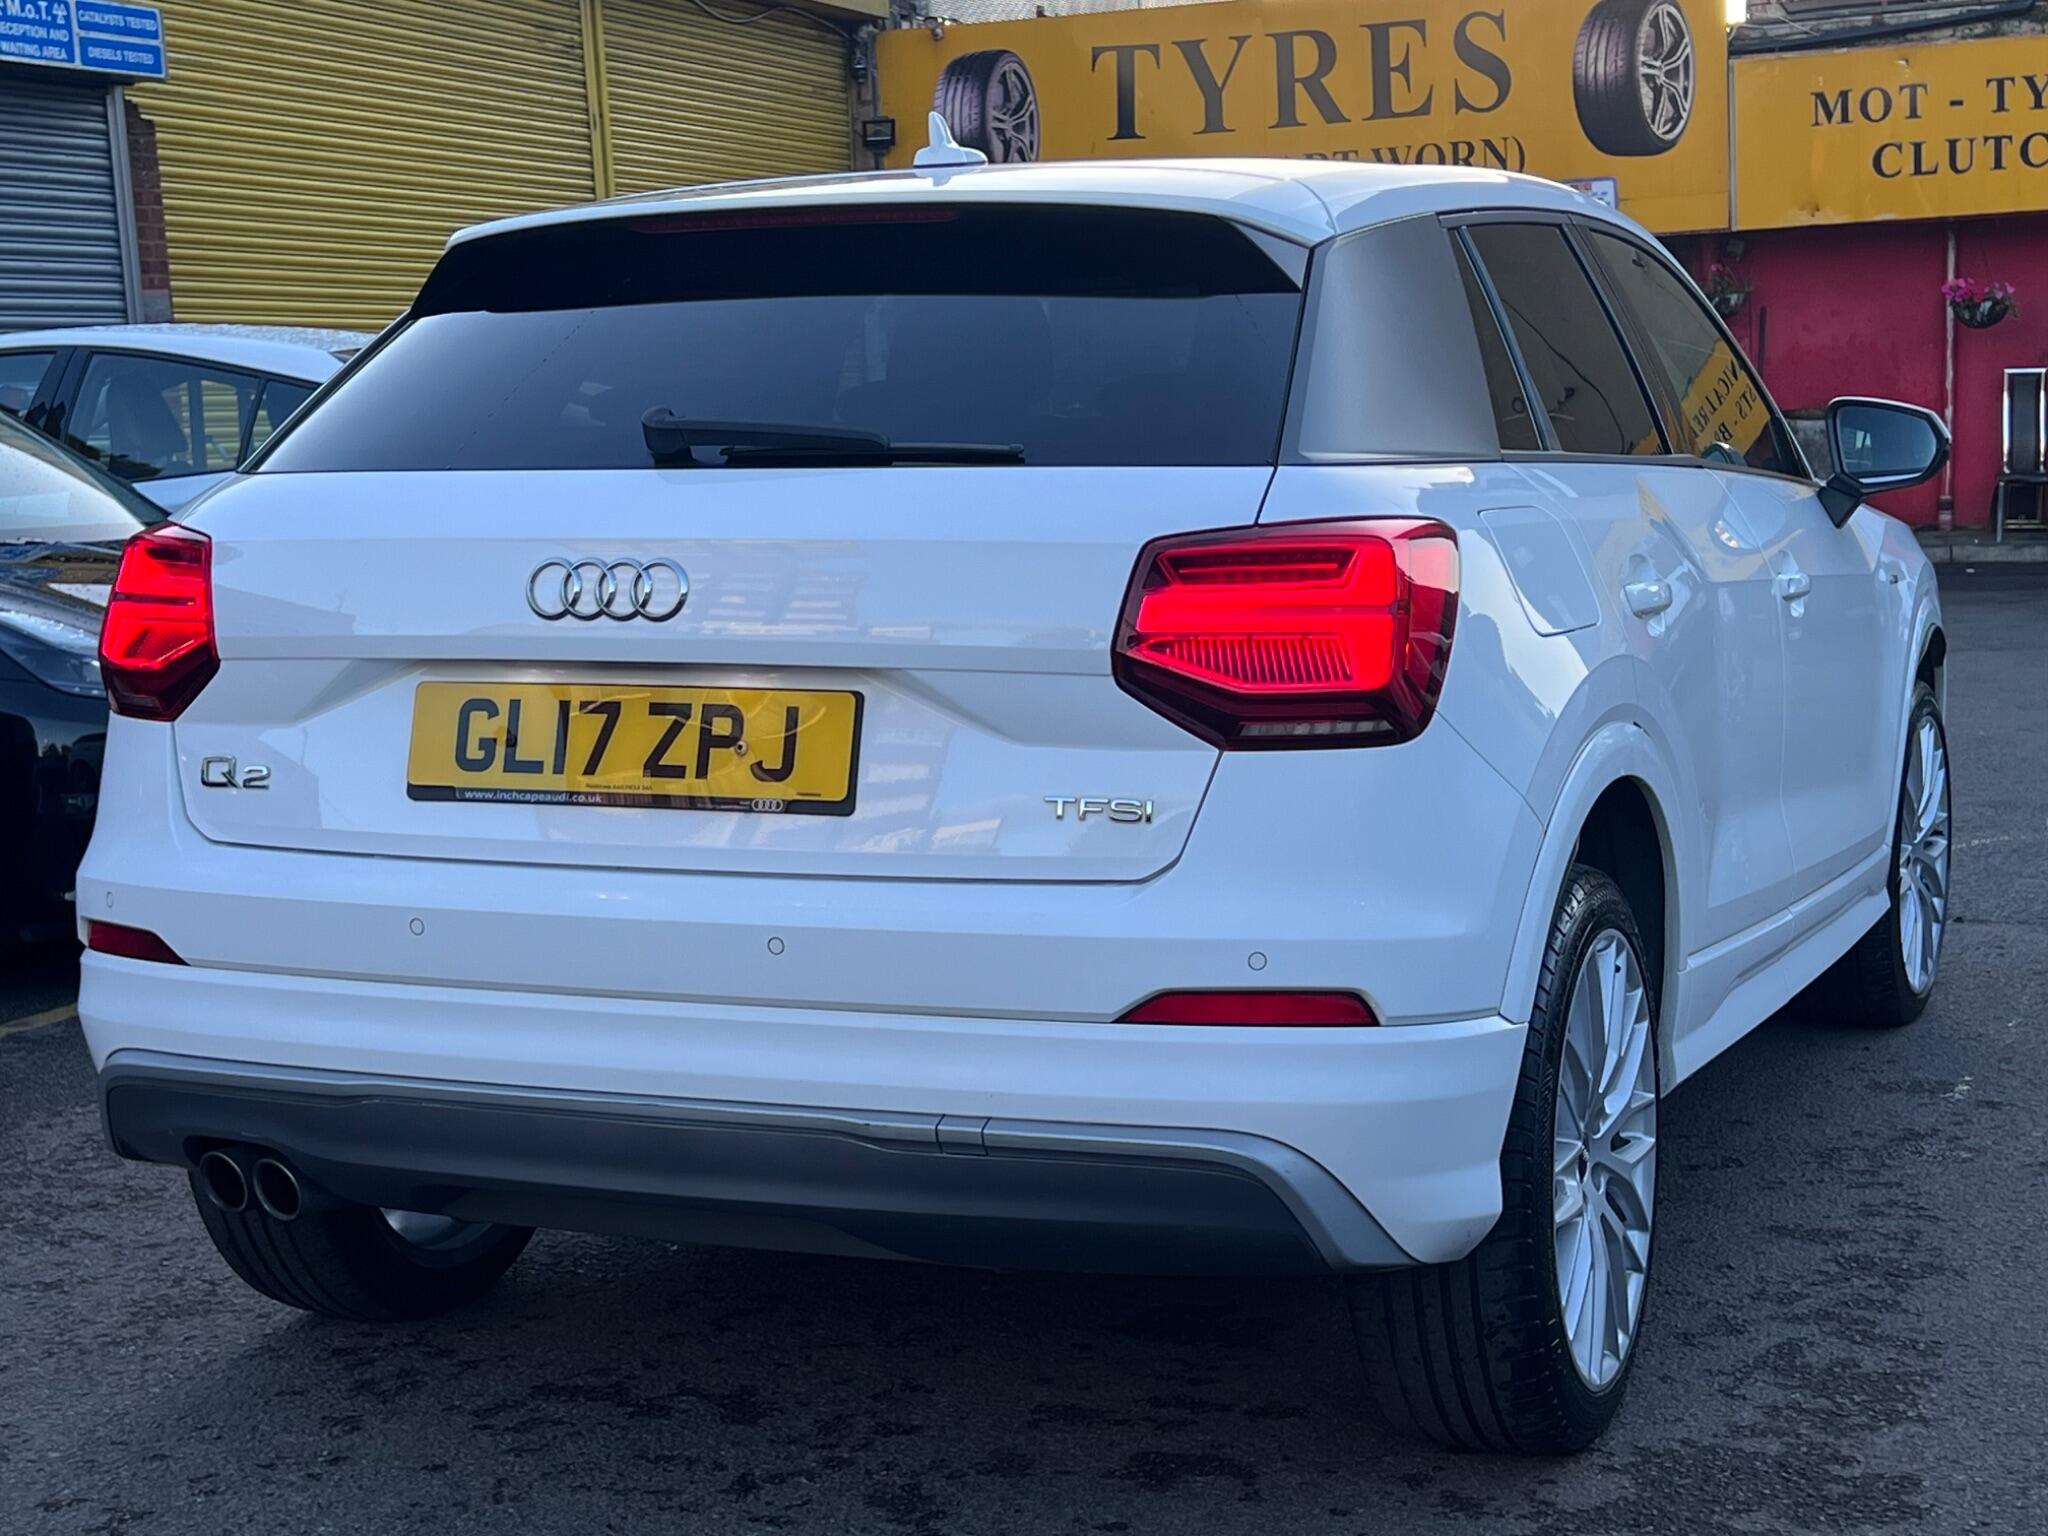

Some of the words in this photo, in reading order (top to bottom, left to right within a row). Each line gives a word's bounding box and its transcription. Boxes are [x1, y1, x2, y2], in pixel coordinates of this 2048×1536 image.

[78, 10, 125, 27] CATALYSTS
[125, 16, 157, 31] TESTED
[49, 28, 69, 42] AND
[42, 46, 68, 60] AREA
[87, 46, 122, 61] DIESELS
[123, 50, 154, 65] TESTED
[1092, 9, 1512, 141] TYRES
[1810, 83, 1928, 127] MOT
[1985, 73, 2048, 114] TY
[1872, 131, 2048, 179] CLUTC
[454, 697, 622, 776] GL17
[643, 702, 799, 783] ZPJ
[201, 756, 271, 790] Q2
[464, 790, 602, 804] www.inchcapeaudi.co.uk
[1043, 796, 1153, 823] TFSI
